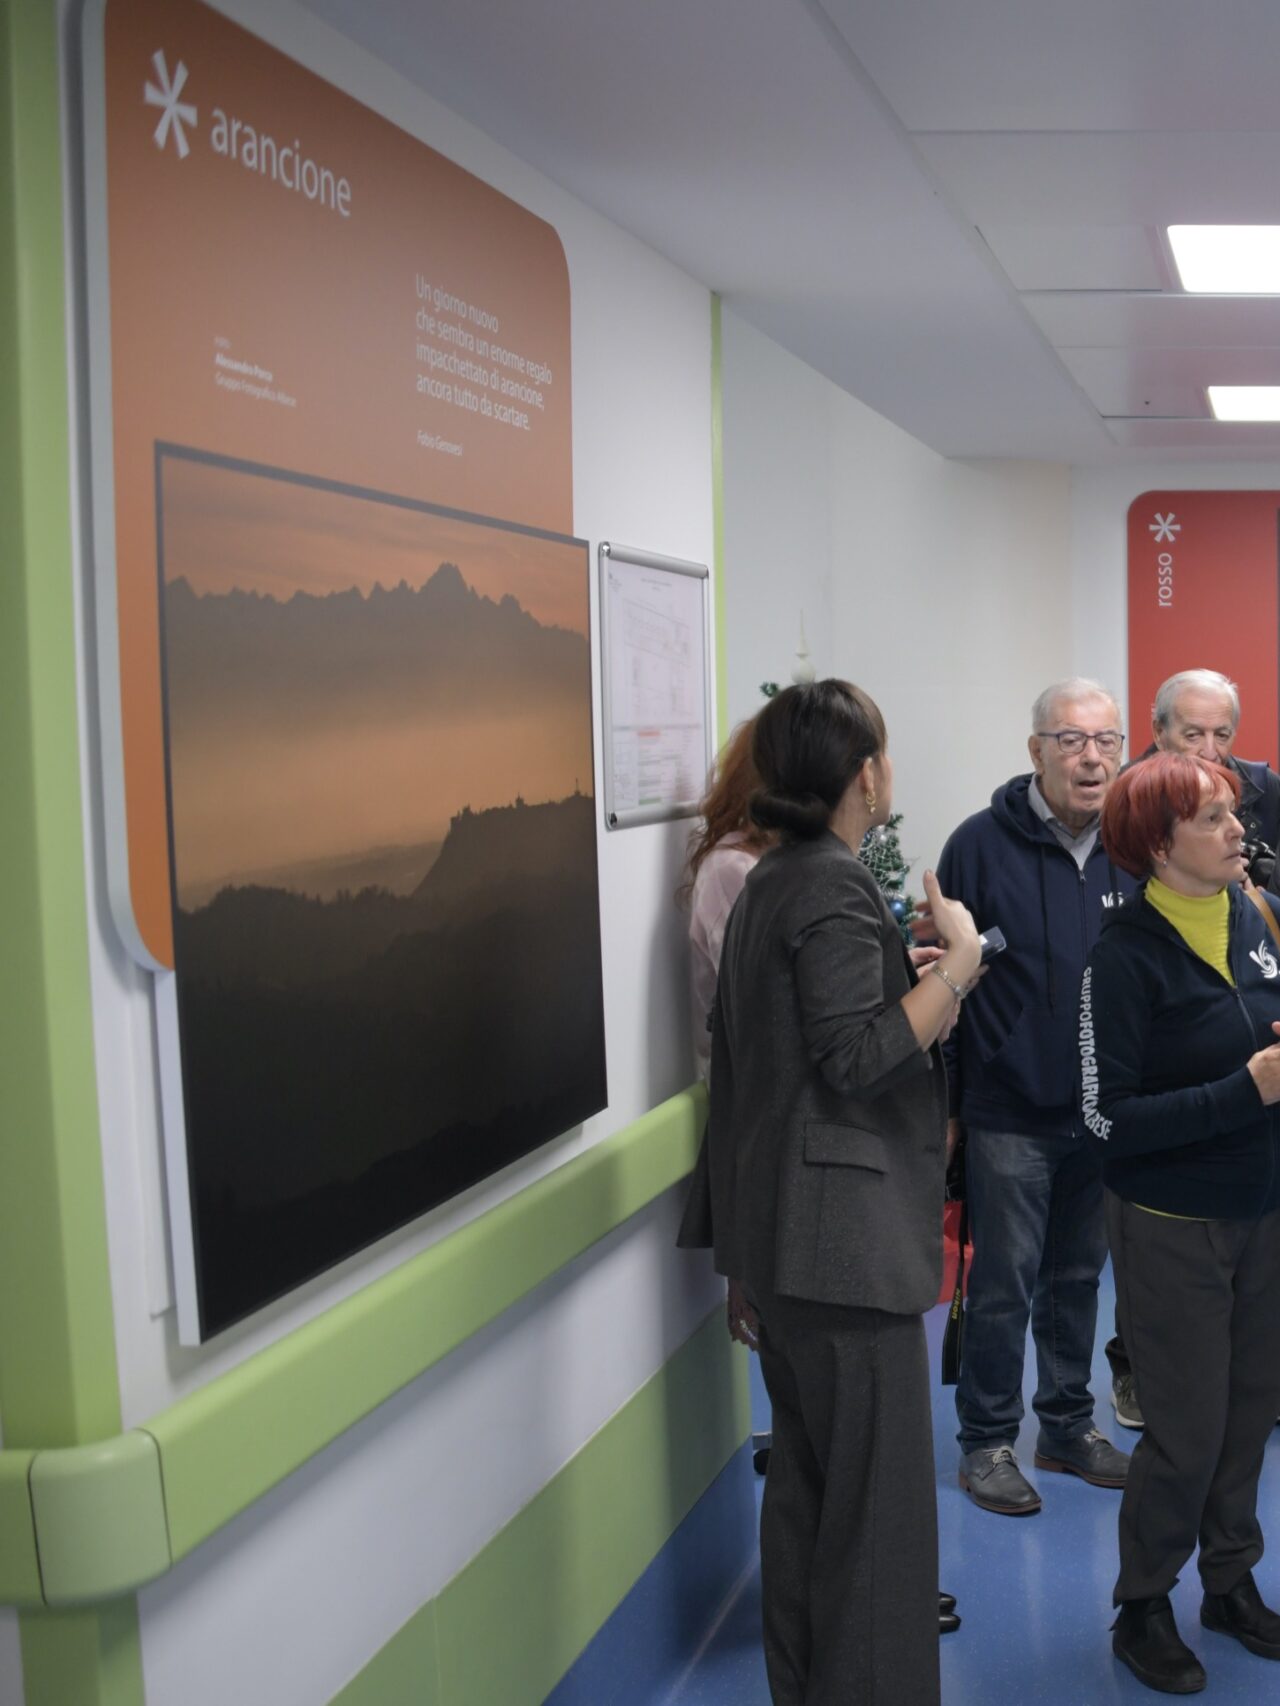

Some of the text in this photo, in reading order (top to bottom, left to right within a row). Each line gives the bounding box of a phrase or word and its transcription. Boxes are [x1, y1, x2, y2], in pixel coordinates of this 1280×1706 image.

[211, 107, 351, 218] arancione
[416, 272, 499, 334] Un giorno nuovo
[416, 306, 552, 386] che sembra un enorme regalo
[416, 336, 489, 387] impacchettato
[490, 368, 500, 391] di
[416, 374, 452, 403] ancora
[454, 384, 479, 412] tutto
[480, 393, 492, 417] da
[1158, 552, 1173, 608] rosso
